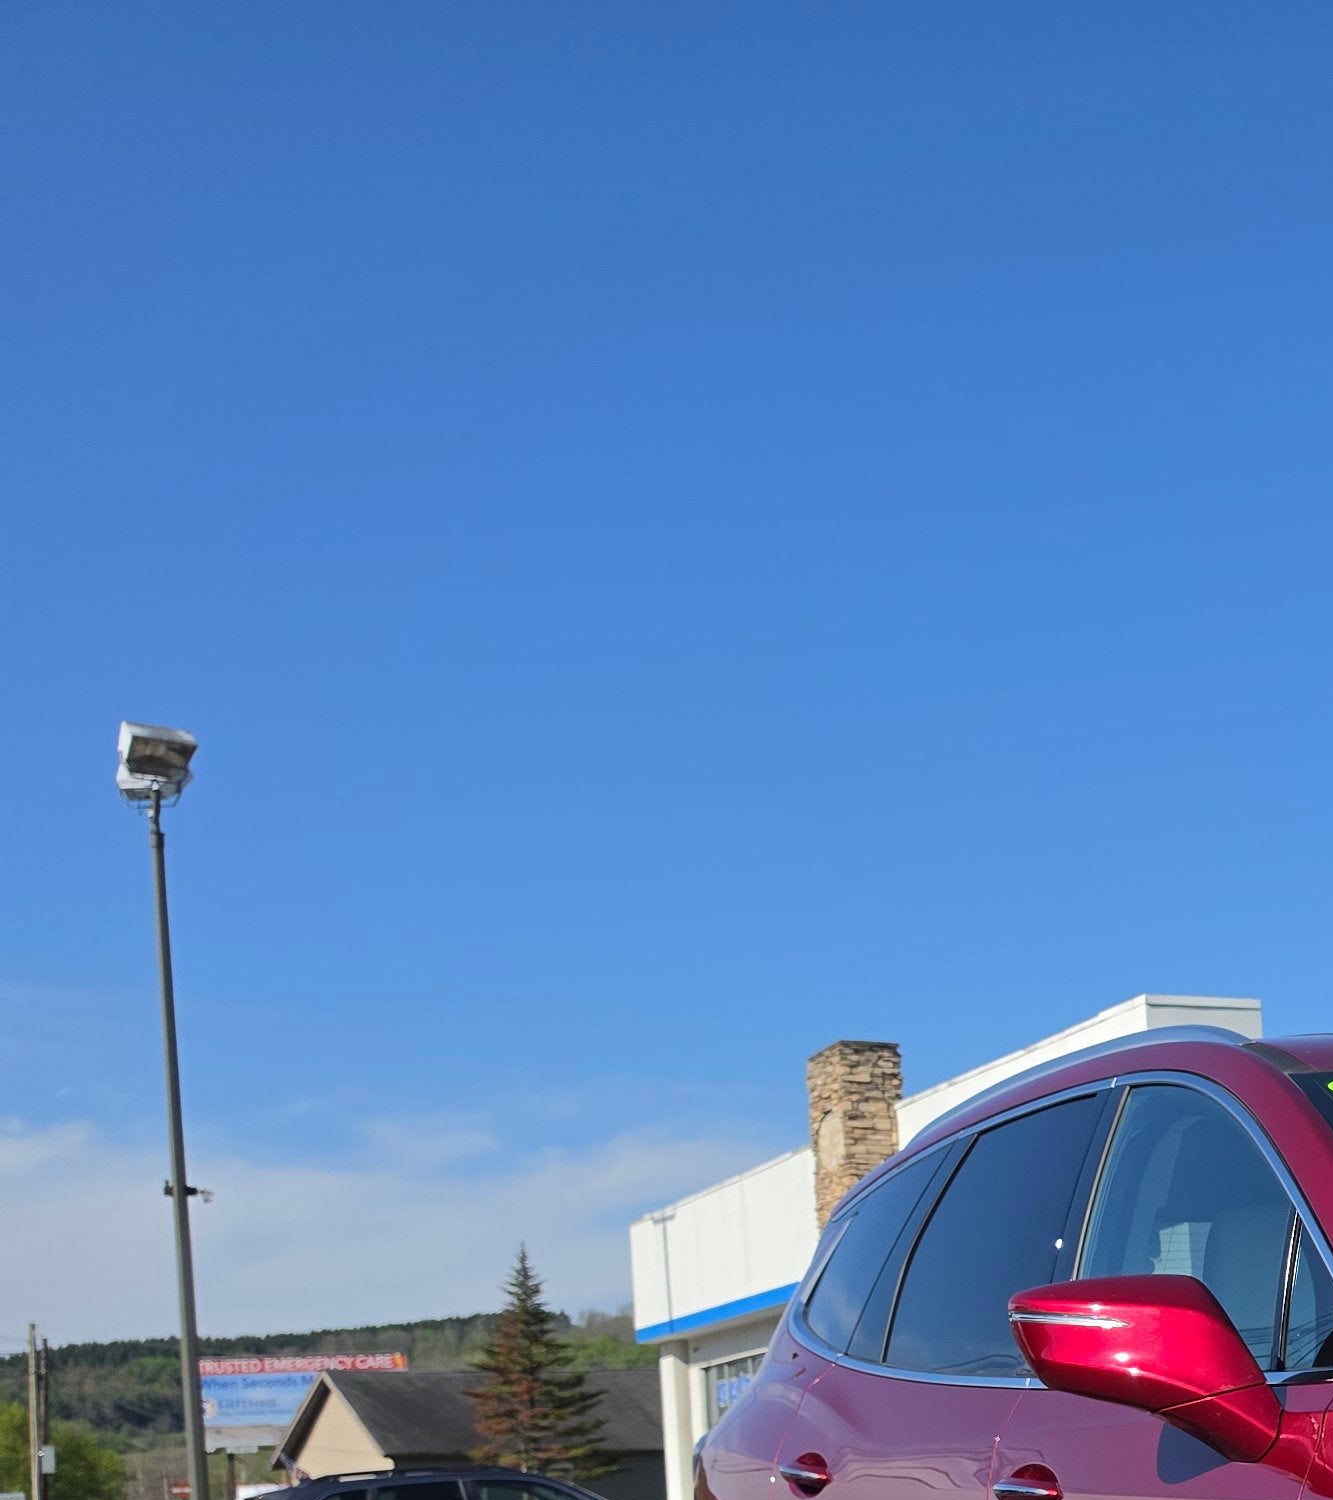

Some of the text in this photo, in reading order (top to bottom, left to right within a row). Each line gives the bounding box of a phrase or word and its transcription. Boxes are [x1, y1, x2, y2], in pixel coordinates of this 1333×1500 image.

[199, 1354, 394, 1374] TRUSTED EMERGENCY CARE
